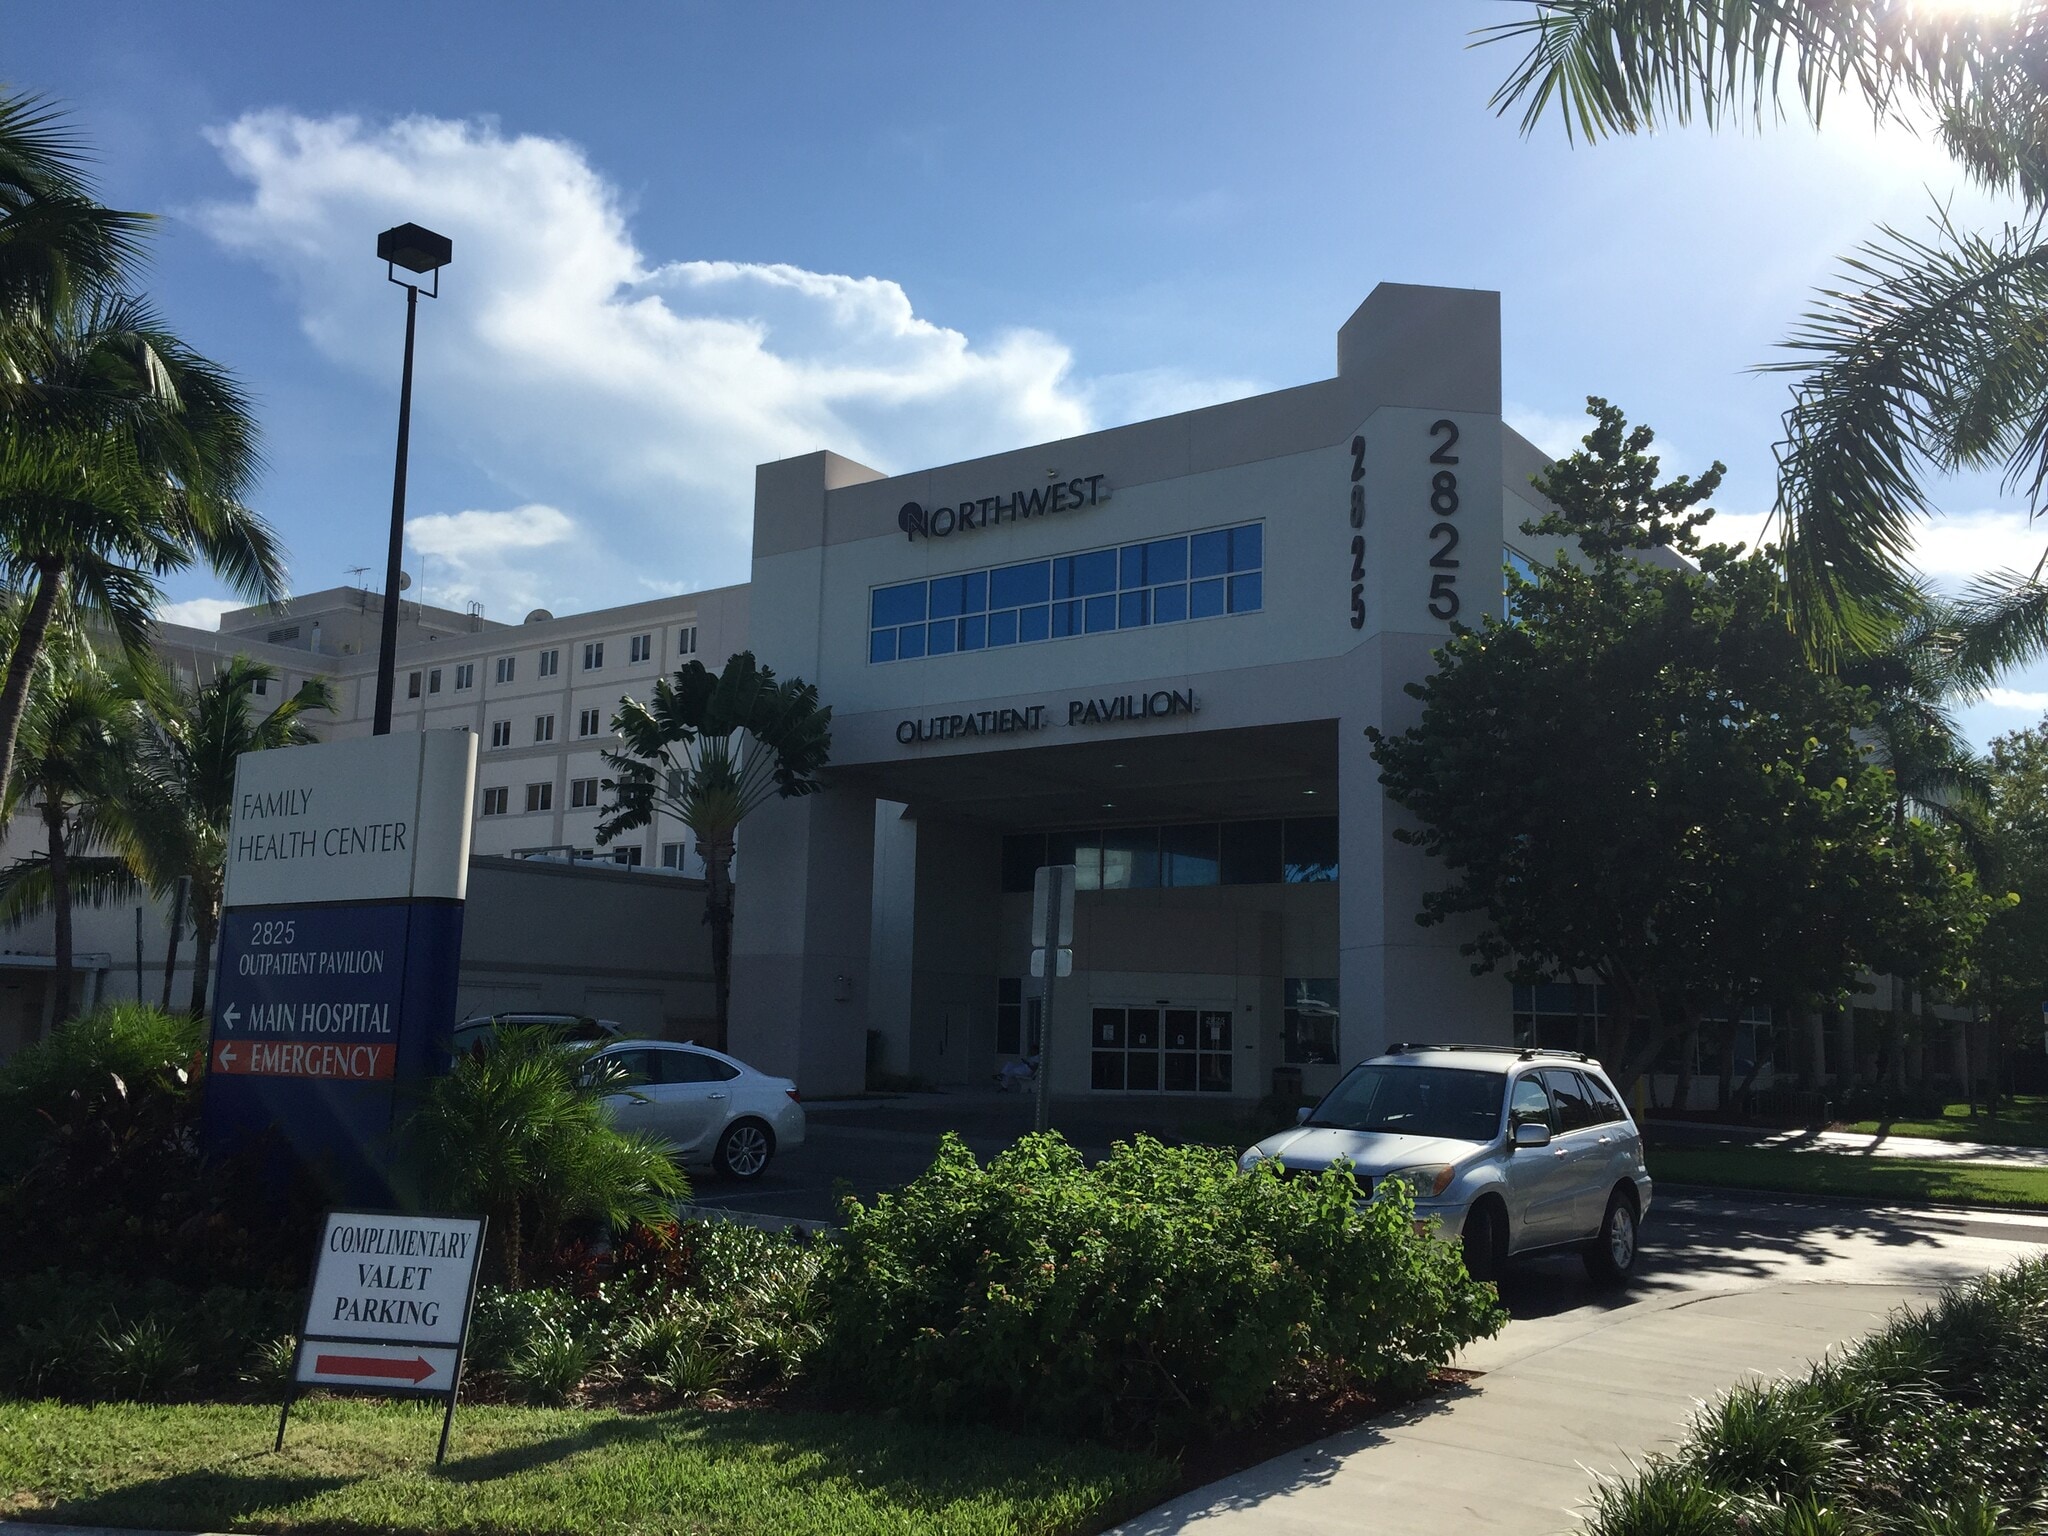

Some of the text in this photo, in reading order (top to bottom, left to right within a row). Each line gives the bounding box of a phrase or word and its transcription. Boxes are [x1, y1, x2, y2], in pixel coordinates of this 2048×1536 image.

[899, 474, 1104, 542] NORTHWEST
[1428, 419, 1460, 620] 2825
[1350, 435, 1366, 630] 2825
[896, 688, 1194, 744] OUTPATIENT PAVILION
[242, 788, 314, 820] FAMILY
[237, 822, 407, 862] HEALTH CENTER
[250, 920, 296, 946] 2825
[238, 949, 385, 976] OUTPATIENT PAVILION
[247, 1003, 392, 1033] MAIN HOSPITAL
[250, 1043, 381, 1077] EMERGENCY
[330, 1226, 471, 1259] COMPLIMENTARY
[358, 1264, 432, 1291] VALET
[332, 1296, 440, 1327] PARKING
